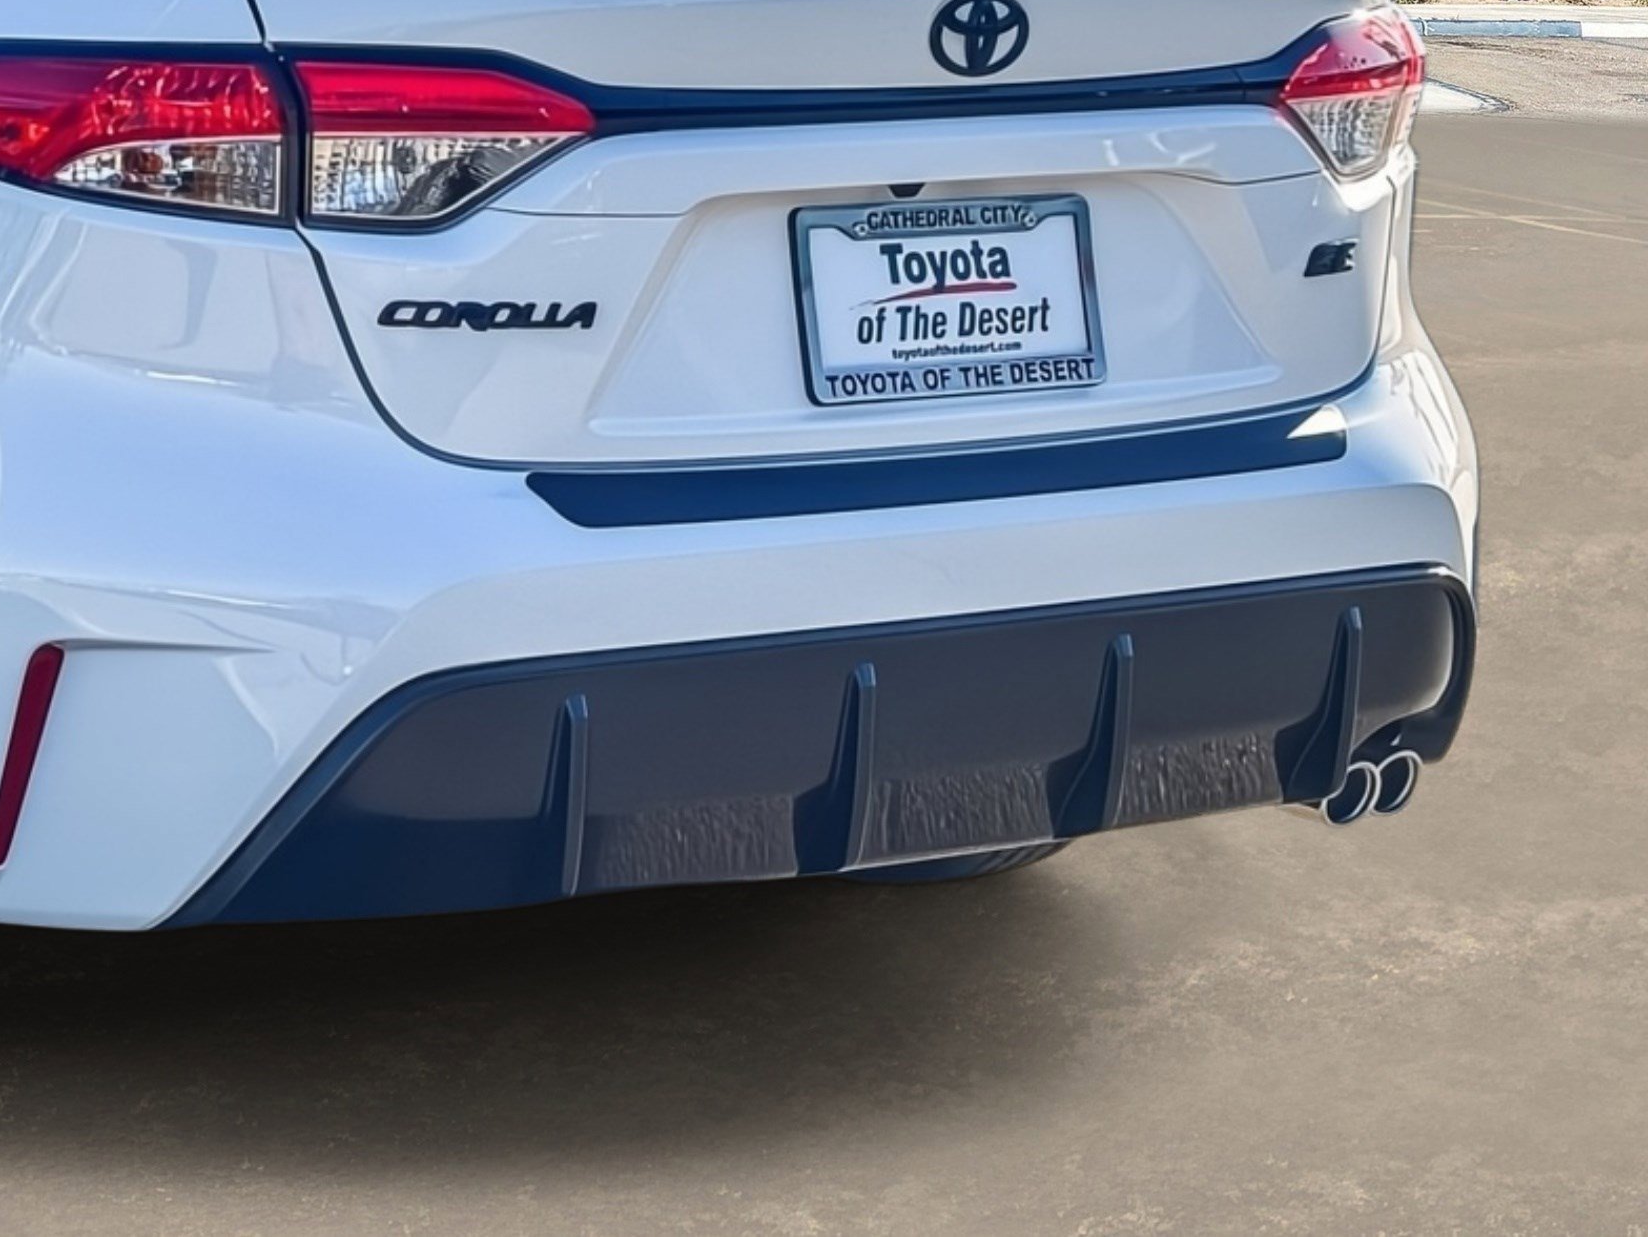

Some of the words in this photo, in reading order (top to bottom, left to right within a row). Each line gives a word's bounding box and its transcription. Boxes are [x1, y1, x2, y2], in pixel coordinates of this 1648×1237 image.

[866, 207, 976, 232] CATHEDRAL
[981, 204, 1024, 225] CITY
[879, 240, 1013, 292] Toyota
[377, 300, 597, 332] COROLLA
[857, 306, 887, 345] of
[895, 304, 948, 342] The
[957, 297, 1051, 338] Desert
[825, 371, 916, 398] TOYOTA
[922, 368, 953, 392] OF
[962, 364, 1004, 388] THE
[1010, 357, 1096, 385] DESERT
